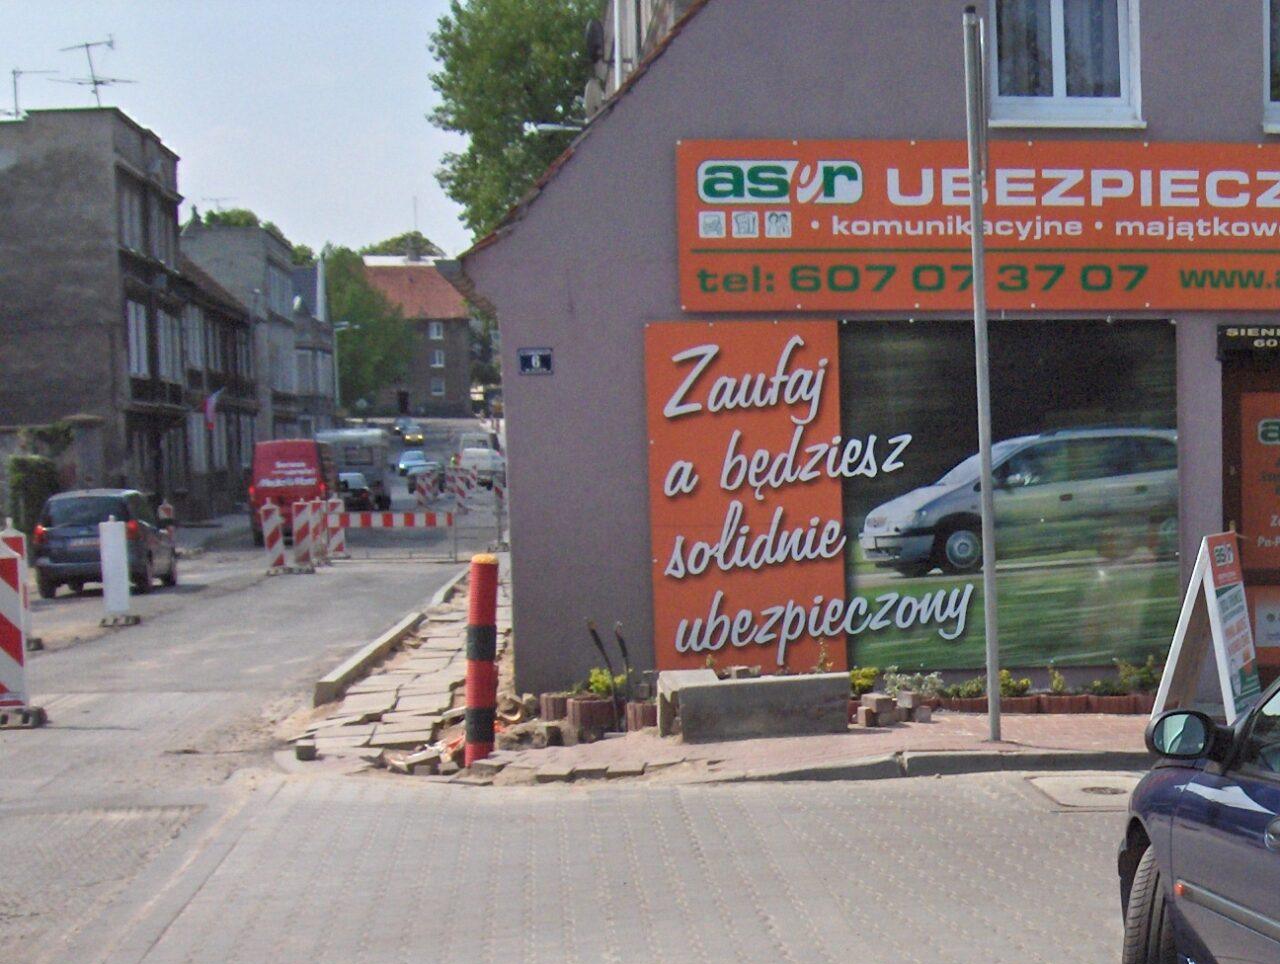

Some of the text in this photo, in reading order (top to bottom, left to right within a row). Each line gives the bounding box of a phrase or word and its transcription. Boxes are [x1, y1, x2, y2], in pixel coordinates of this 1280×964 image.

[832, 215, 1083, 240] komunikacyjne
[697, 265, 774, 293] tel:
[789, 264, 896, 292] 607
[912, 264, 974, 292] 07
[997, 264, 1065, 292] 37
[1081, 264, 1149, 292] 07
[531, 354, 540, 368] 6
[663, 334, 829, 424] Zaufaj
[663, 425, 913, 500] a będziesz
[663, 500, 847, 579] solidnie
[674, 583, 974, 666] ubezpieczony
